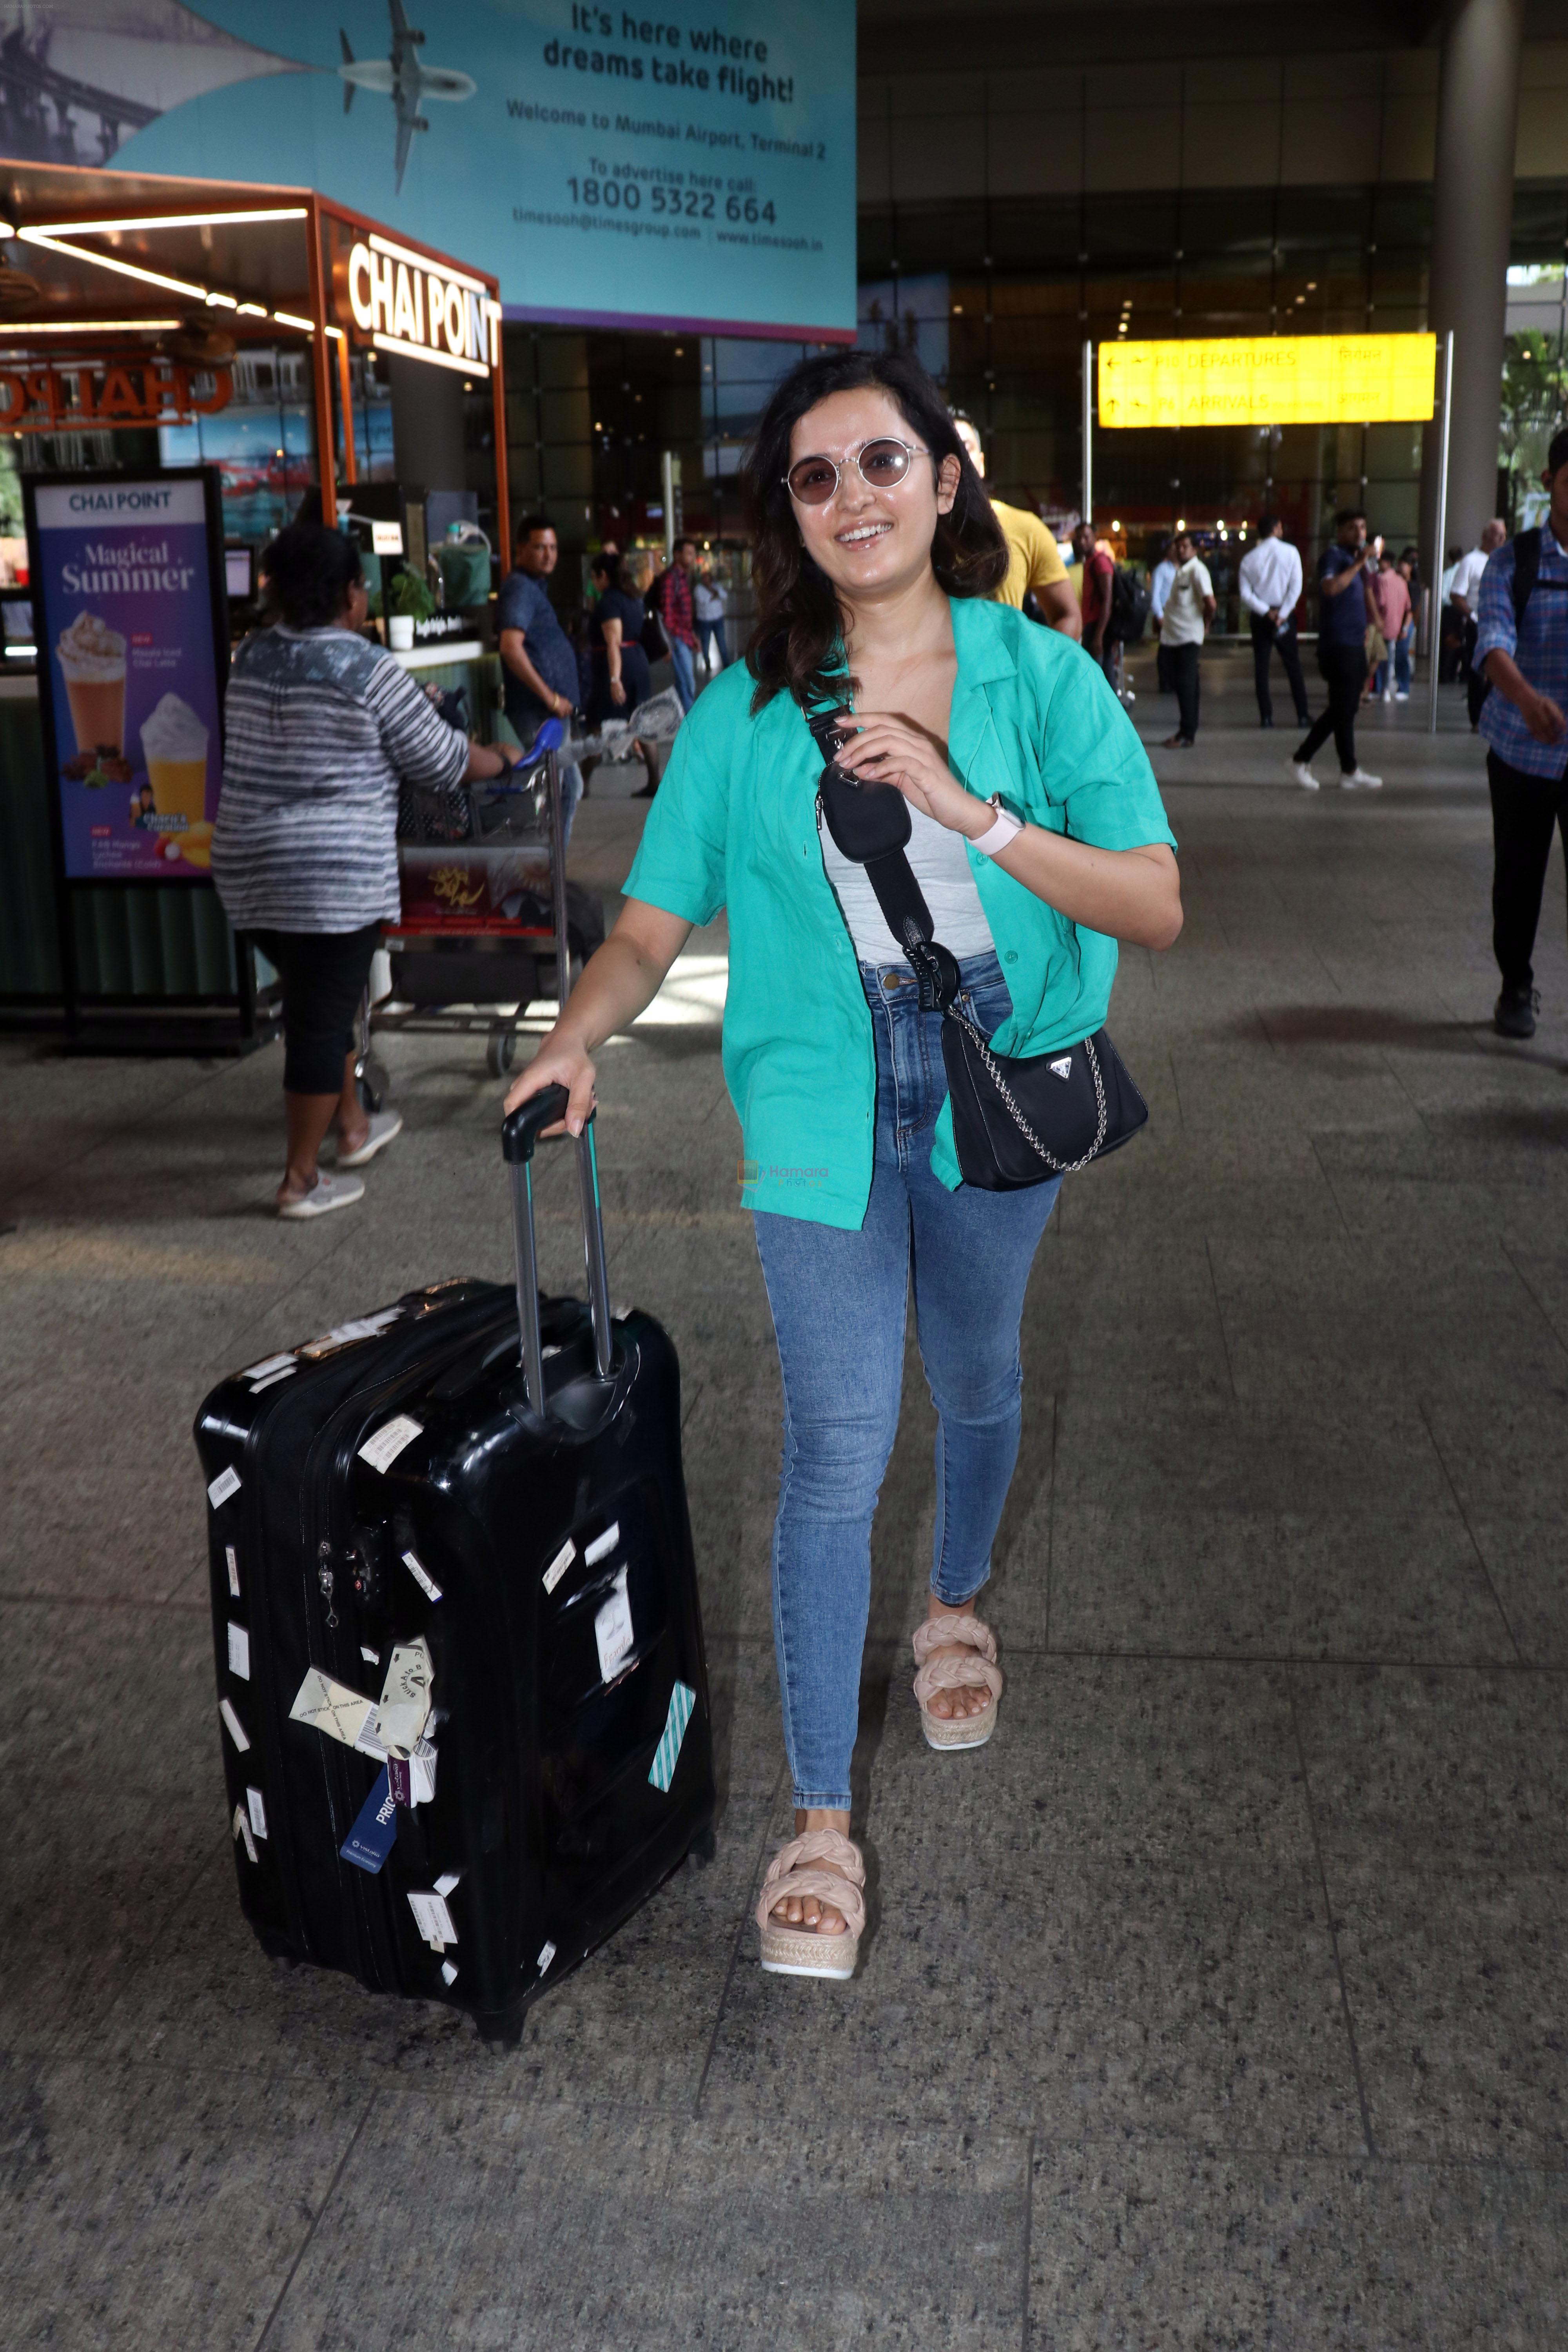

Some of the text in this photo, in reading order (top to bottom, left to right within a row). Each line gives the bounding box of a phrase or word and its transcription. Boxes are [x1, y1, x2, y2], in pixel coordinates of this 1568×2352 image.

[571, 4, 768, 62] It's here where
[544, 38, 794, 104] dreams take flight!
[507, 99, 825, 159] Welcome to Mumbai Airport, Terminal 2
[590, 158, 607, 175] To
[613, 162, 684, 186] advertise
[689, 172, 722, 190] here
[567, 177, 777, 225] 1800 5322 664
[513, 207, 823, 252] timesooh@timesgroup.com www.timesooh.in
[348, 242, 503, 368] CHAI POINT
[1155, 351, 1296, 368] P10 DEPARTURES
[1187, 394, 1269, 410] ARRIVALS
[69, 490, 172, 512] CHAI POINT
[85, 541, 169, 571] Magical
[62, 563, 195, 594] Summer
[399, 1682, 416, 1698] Stick
[338, 1728, 347, 1740] AREA
